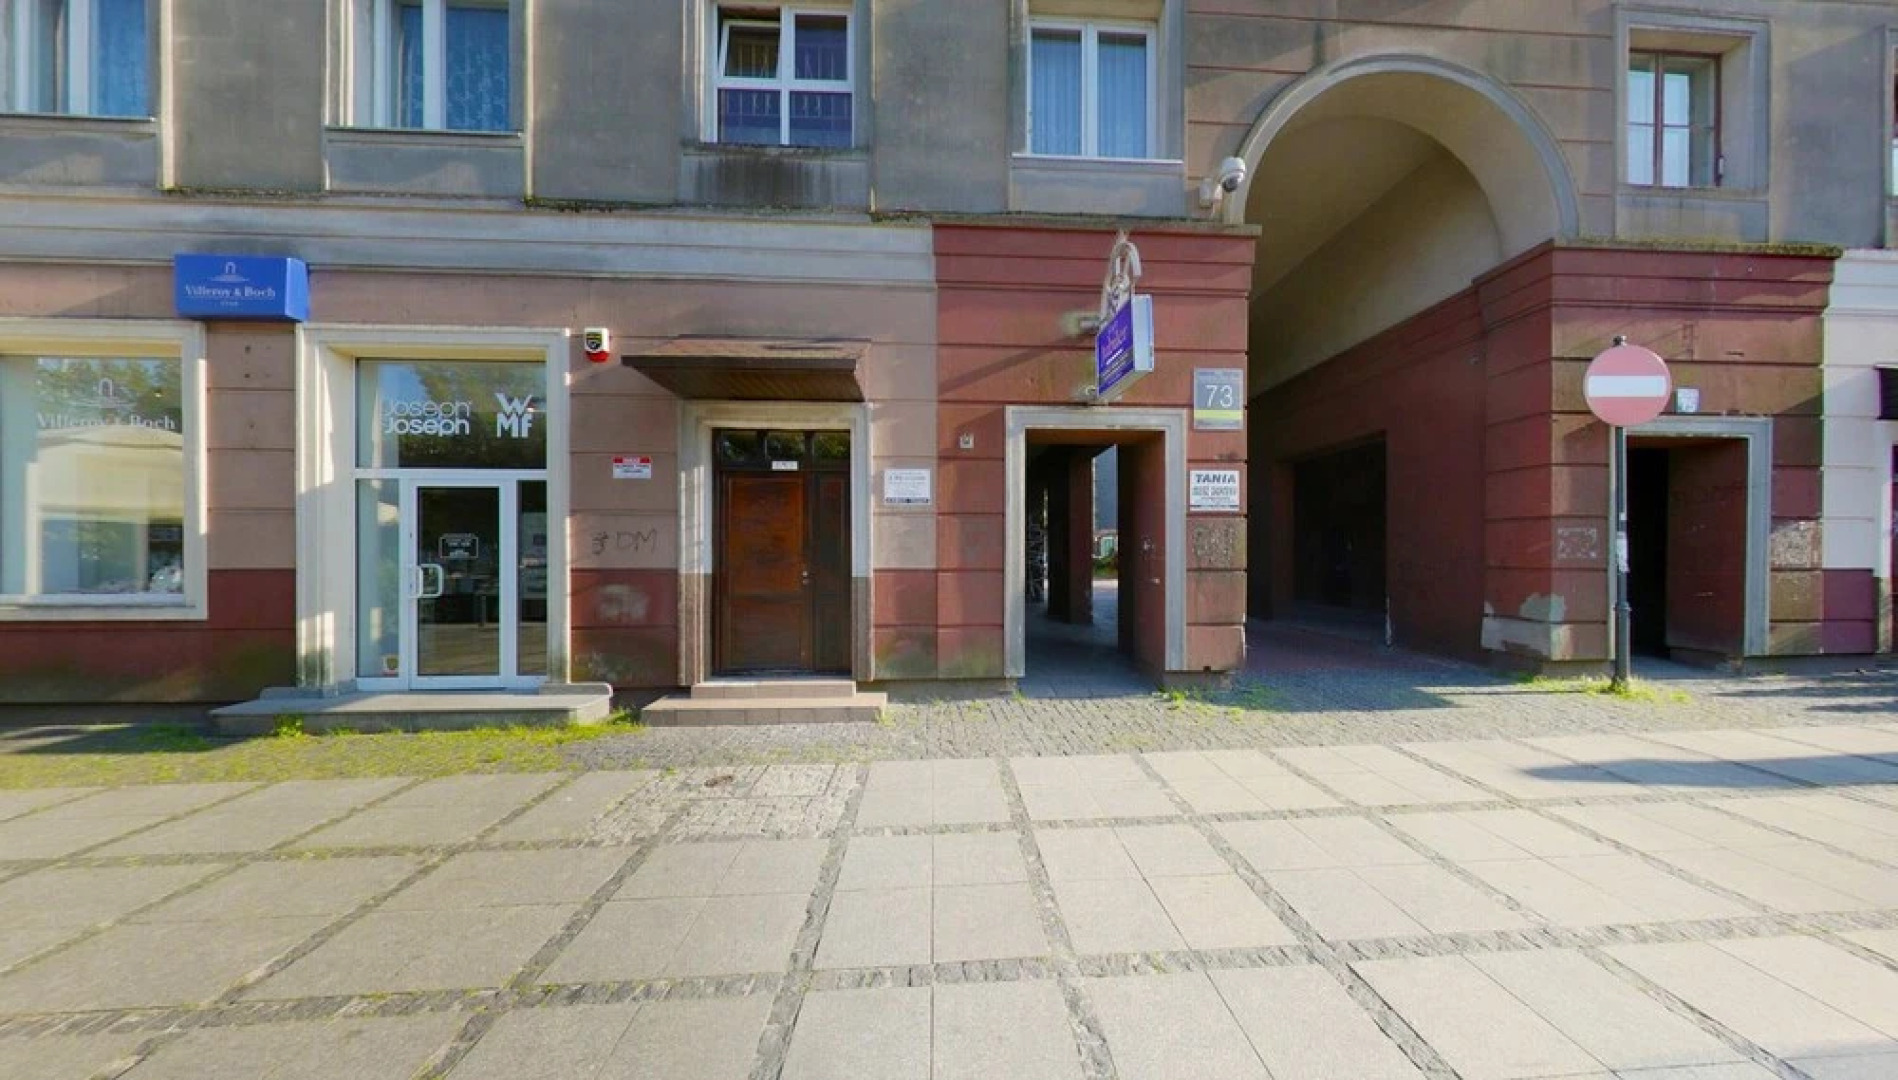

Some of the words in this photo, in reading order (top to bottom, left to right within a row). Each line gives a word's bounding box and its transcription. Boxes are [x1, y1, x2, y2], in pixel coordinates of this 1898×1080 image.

[185, 284, 230, 298] Villeroy
[244, 285, 276, 297] Boch
[1205, 384, 1233, 408] 73
[385, 416, 470, 437] Joseph
[1195, 474, 1237, 484] TANIA
